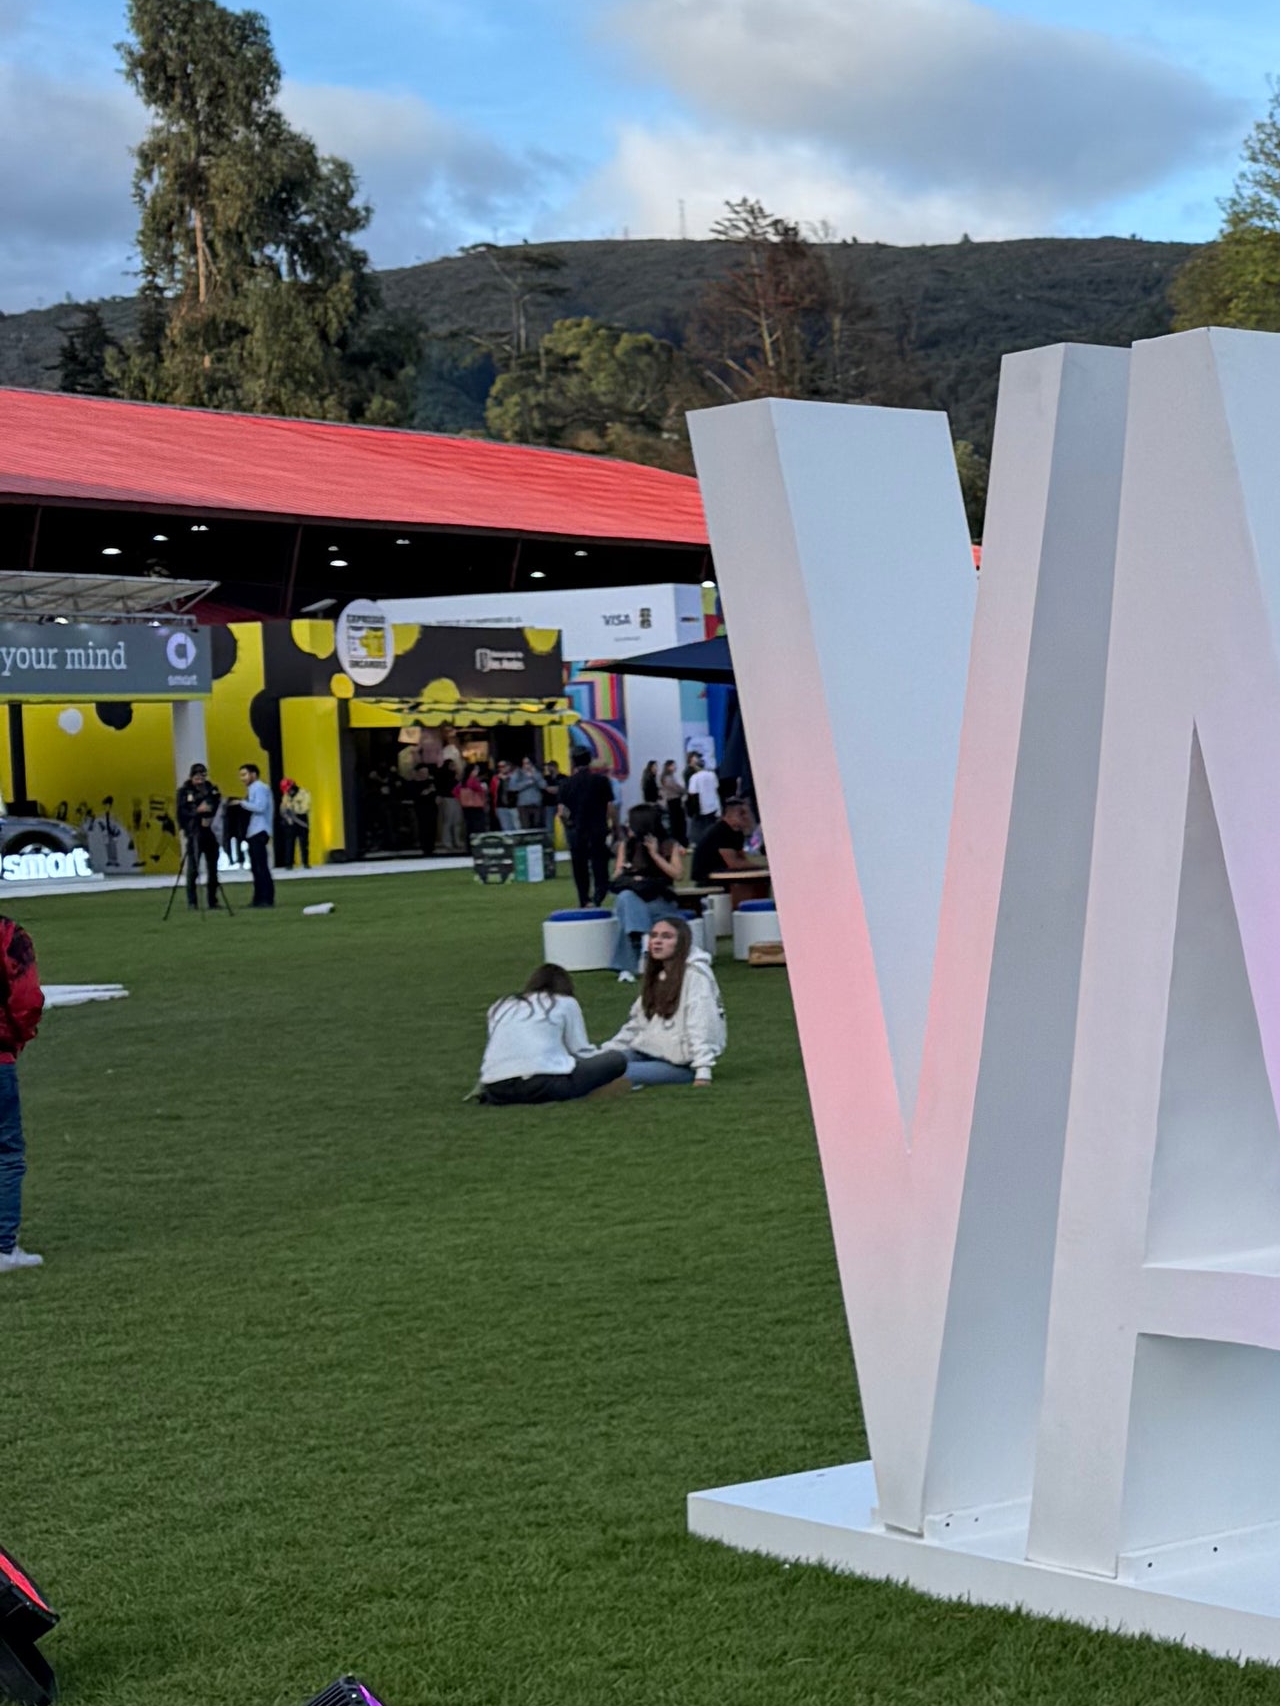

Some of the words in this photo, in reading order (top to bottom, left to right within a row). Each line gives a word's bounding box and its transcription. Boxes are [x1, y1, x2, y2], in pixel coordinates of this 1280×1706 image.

[602, 613, 632, 627] VISA
[0, 646, 58, 677] your
[65, 640, 128, 670] mind
[2, 847, 93, 881] smart
